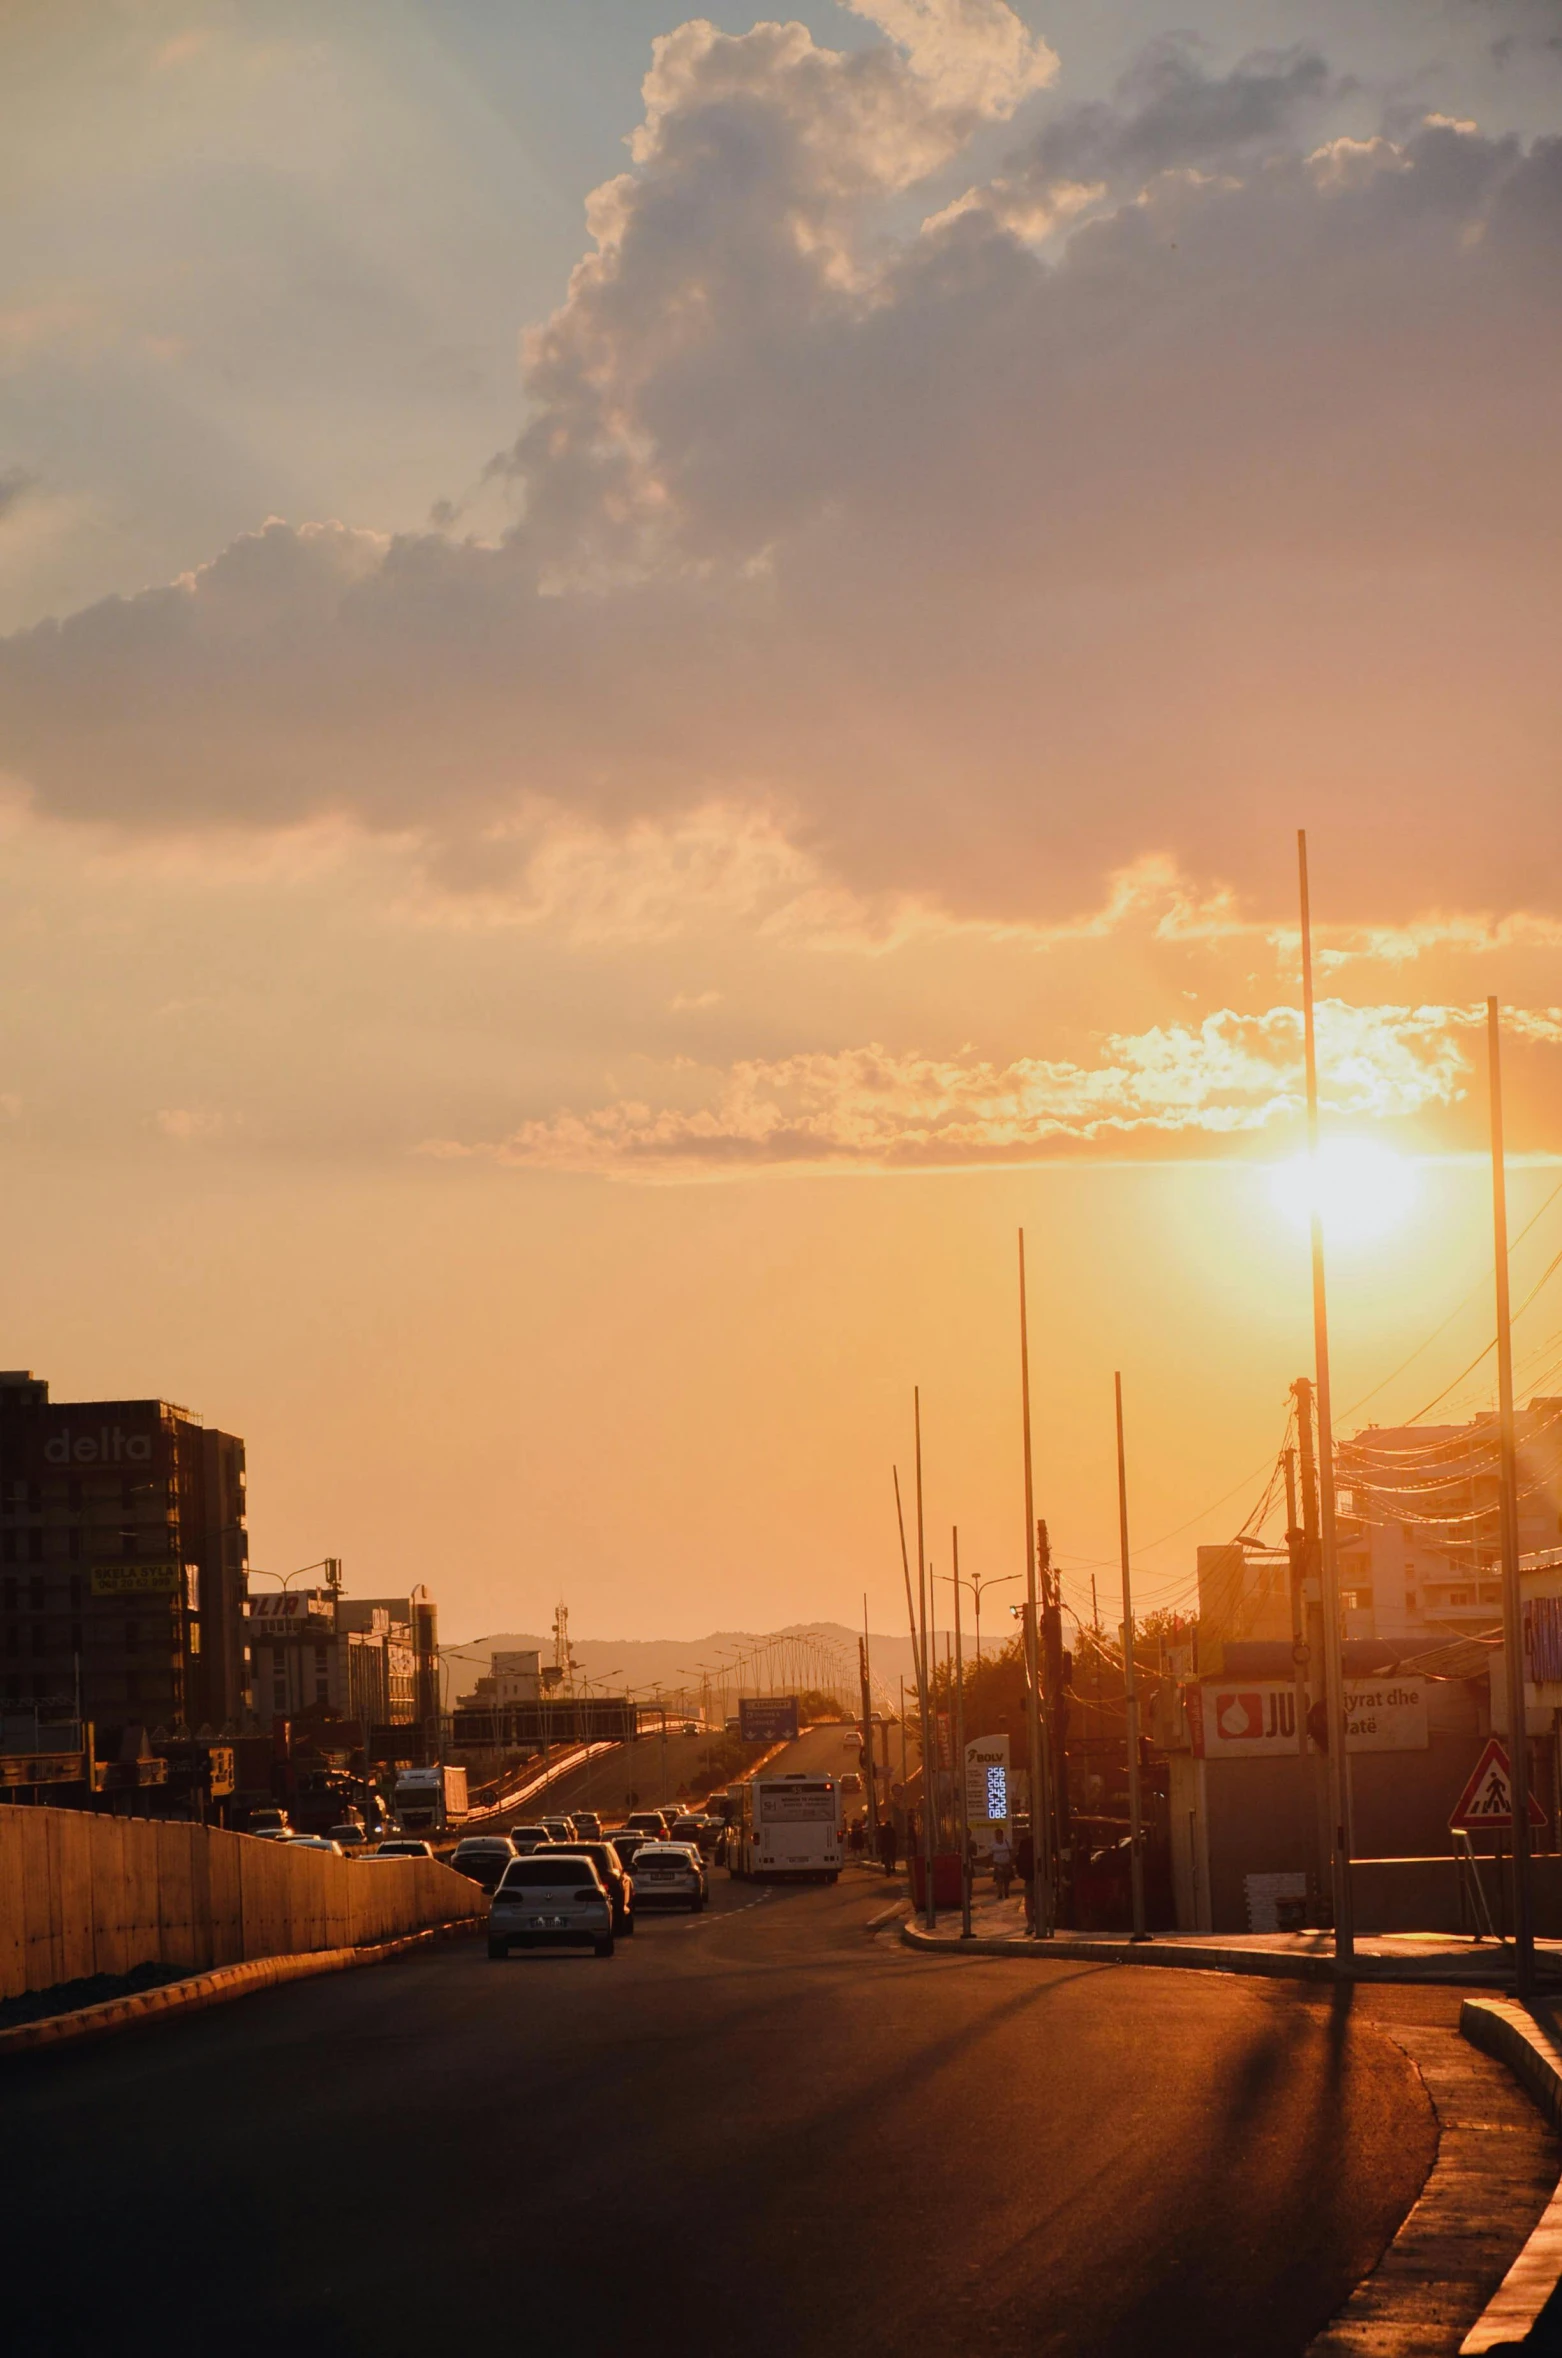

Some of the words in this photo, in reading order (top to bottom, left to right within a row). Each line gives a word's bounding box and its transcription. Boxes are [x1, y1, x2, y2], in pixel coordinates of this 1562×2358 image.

[44, 1426, 152, 1463] delta
[95, 1568, 137, 1579] SKELA
[141, 1566, 174, 1577] SYLA
[1386, 1688, 1419, 1706] dhe
[977, 1753, 1004, 1763] BOLV
[988, 1767, 1005, 1777] 256
[988, 1778, 1006, 1788] 266
[988, 1788, 1006, 1798] 242
[989, 1798, 1006, 1808] 252
[989, 1809, 1007, 1819] 082
